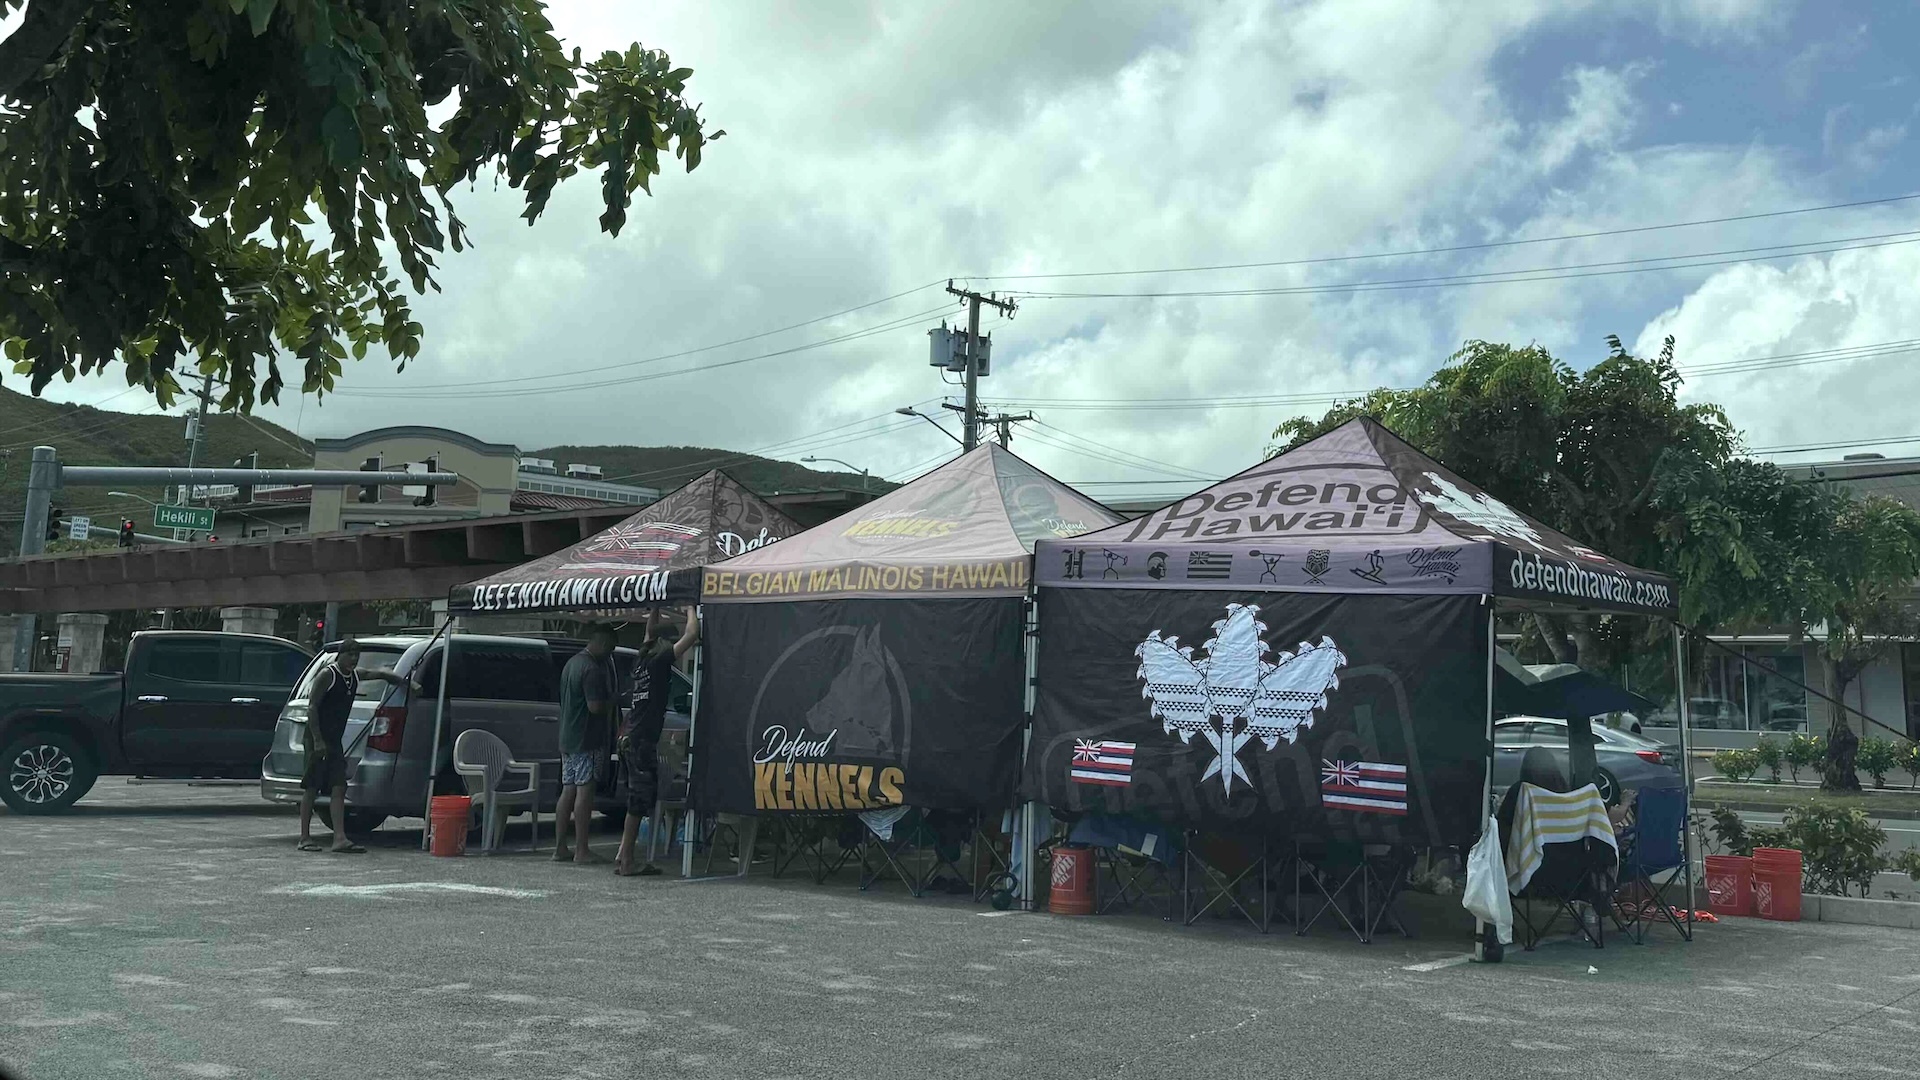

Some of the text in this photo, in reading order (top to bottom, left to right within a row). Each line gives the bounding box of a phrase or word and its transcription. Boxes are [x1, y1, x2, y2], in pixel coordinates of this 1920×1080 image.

[161, 510, 208, 525] Hekili St
[1164, 480, 1408, 521] Defend
[838, 518, 960, 538] KENNELS
[1041, 518, 1087, 534] Defend
[1406, 546, 1463, 566] Defend
[1411, 561, 1461, 577] Hawaii
[472, 570, 670, 611] DEFENDHAWAII.COM
[703, 561, 1024, 595] BELGIAN MALINOIS HAWAII
[1510, 550, 1671, 608] defendhawaii.com
[753, 725, 838, 774] Defend
[754, 762, 905, 809] KENNELS
